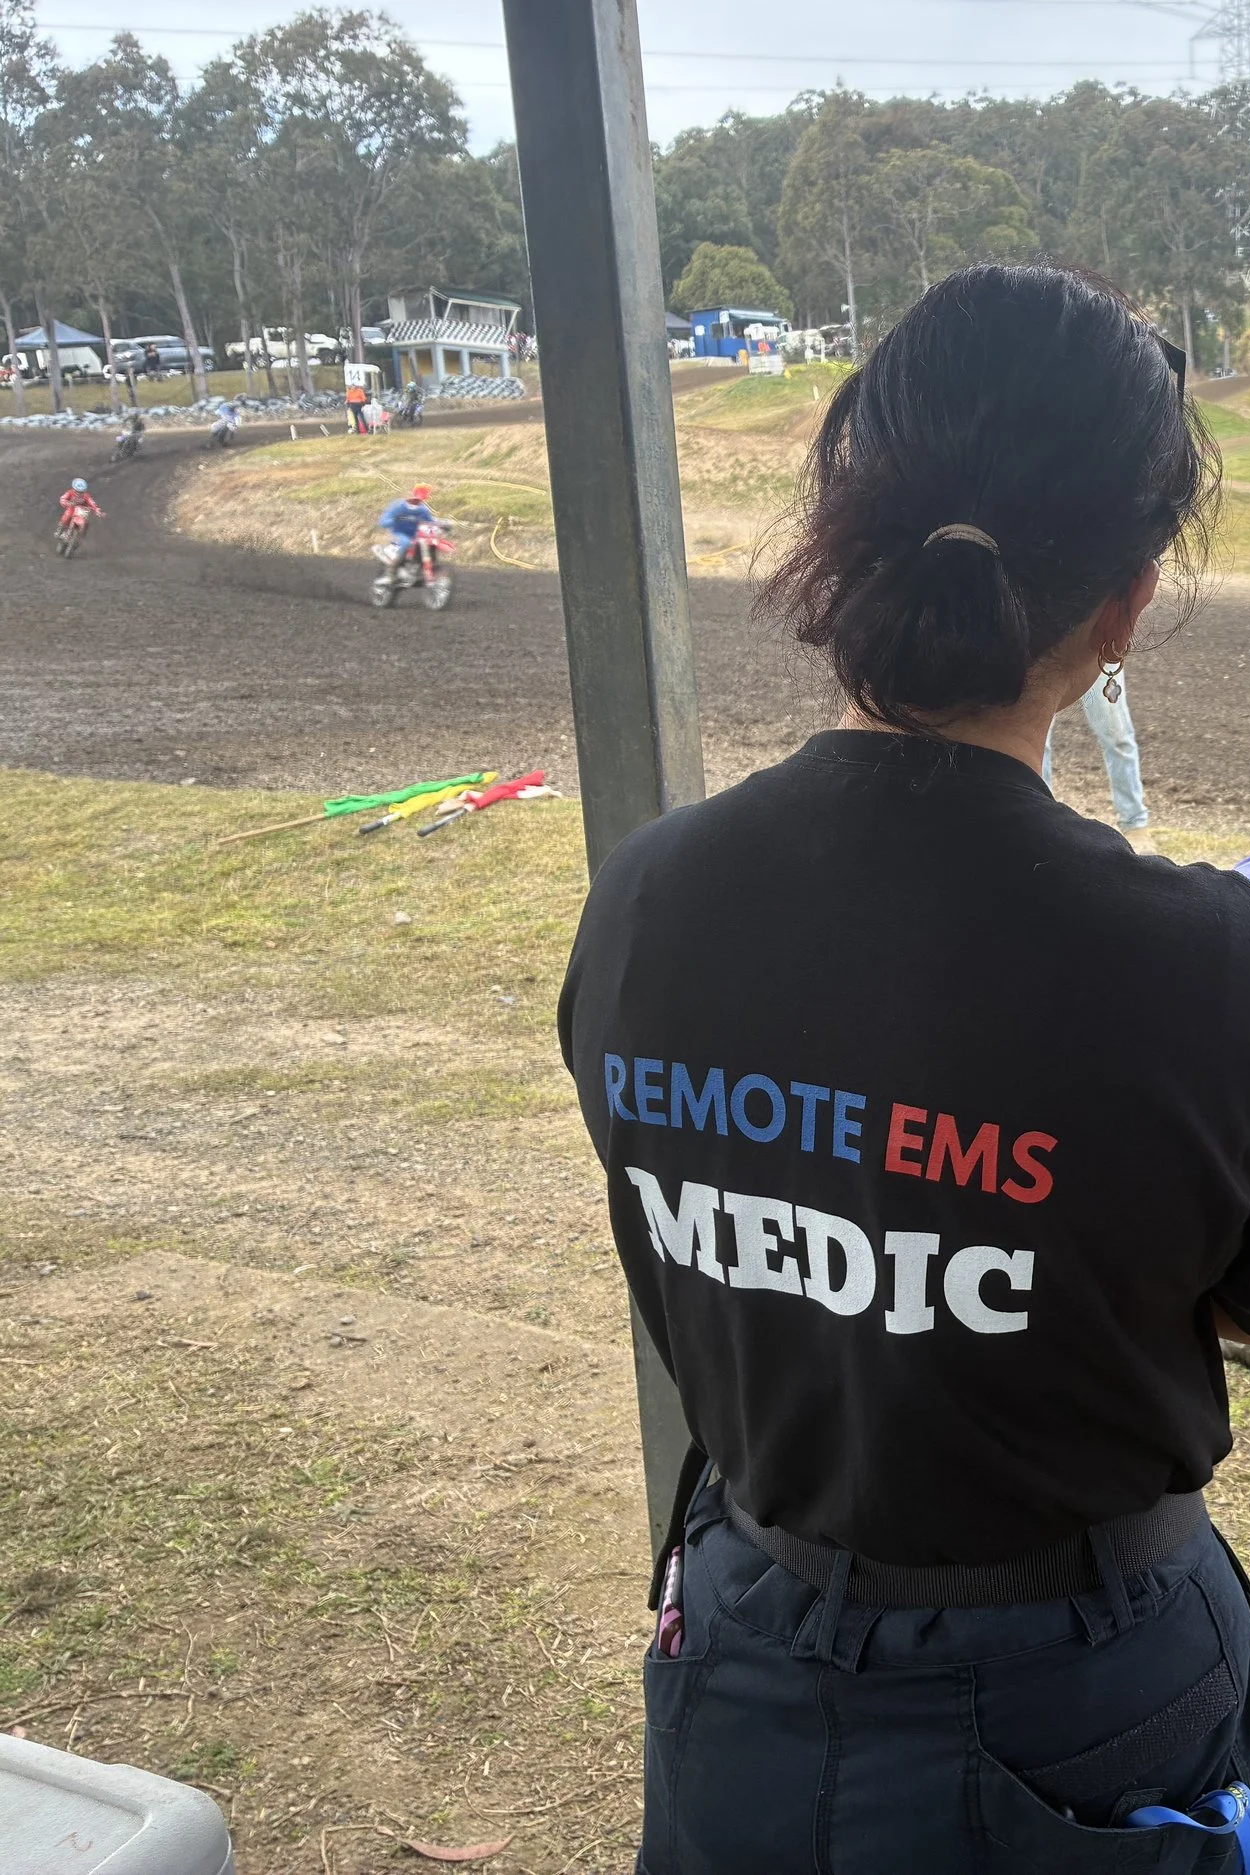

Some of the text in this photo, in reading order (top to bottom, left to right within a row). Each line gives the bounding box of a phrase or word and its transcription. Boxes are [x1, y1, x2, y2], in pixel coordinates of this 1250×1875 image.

[604, 1053, 1058, 1203] REMOTE EMS
[624, 1166, 1035, 1335] MEDIC
